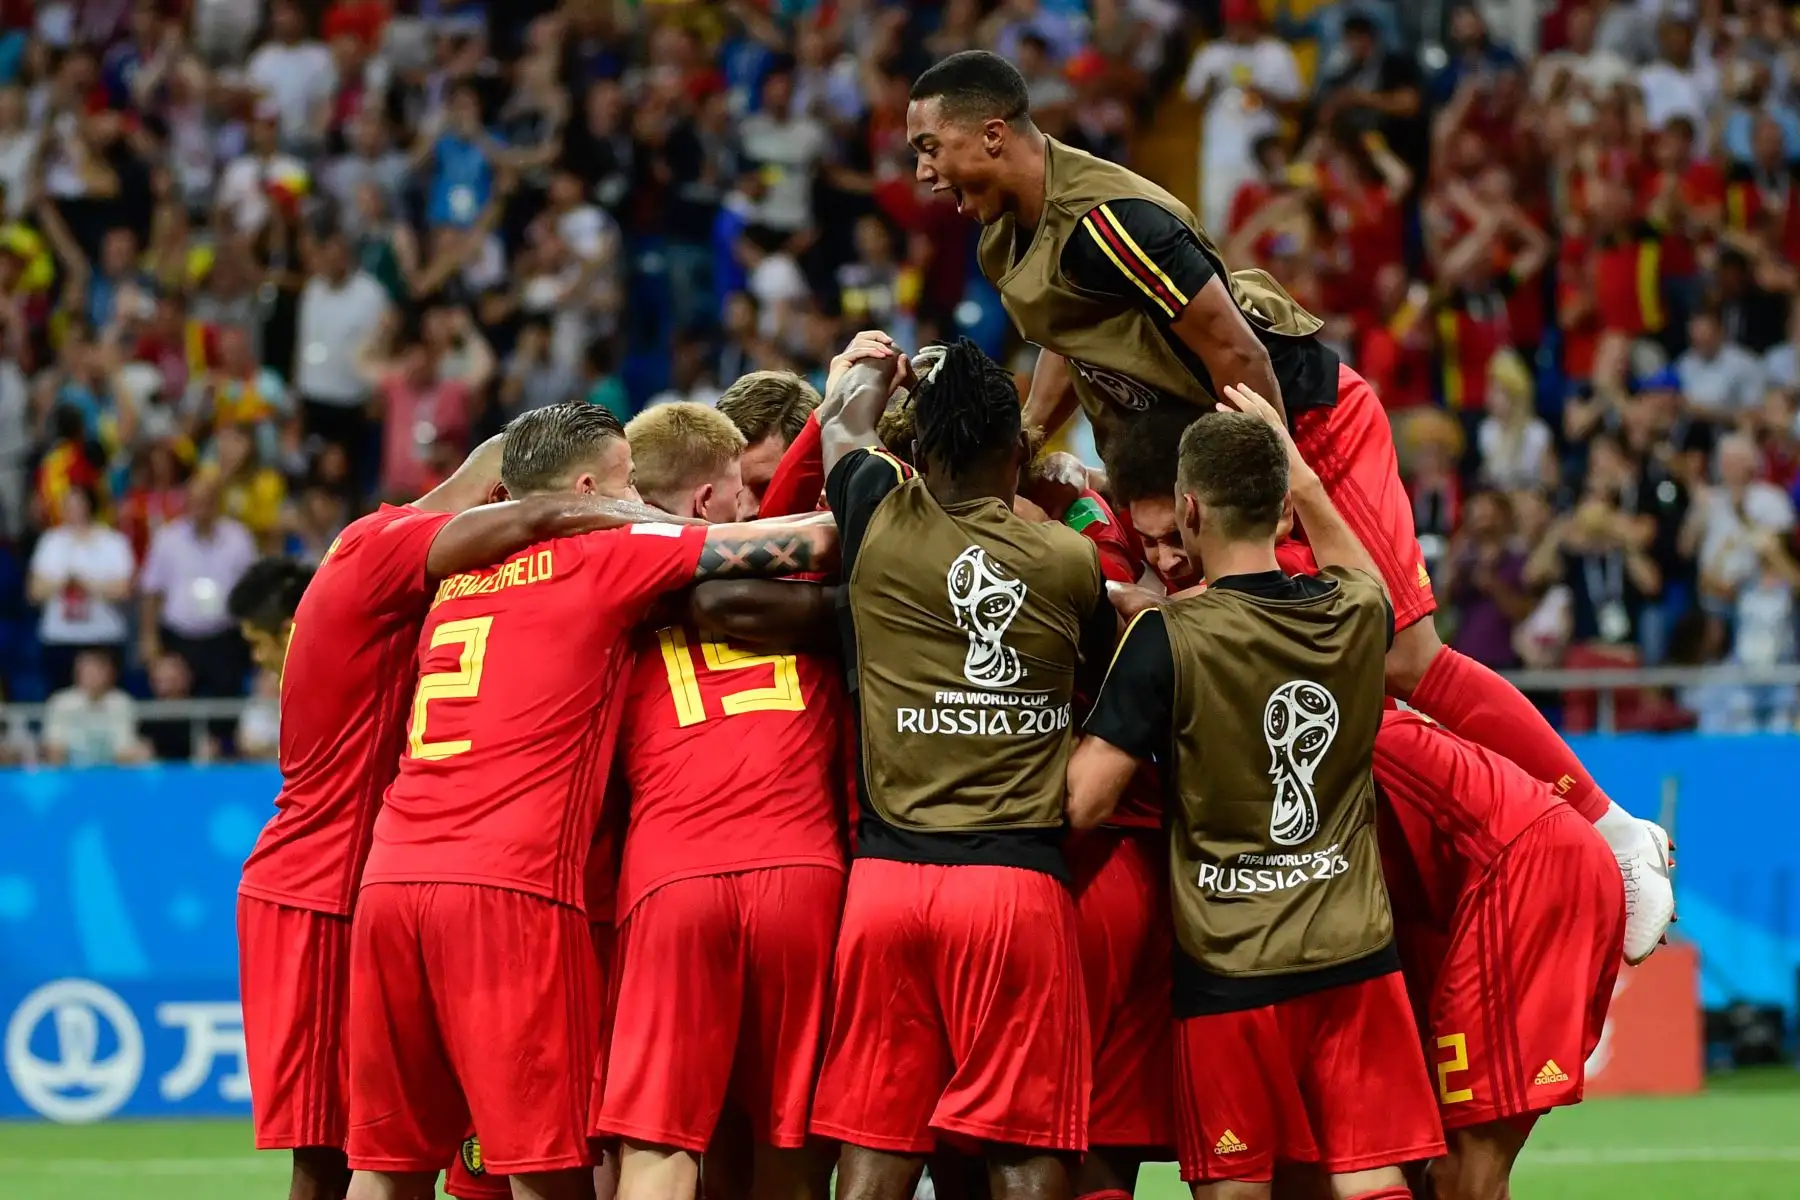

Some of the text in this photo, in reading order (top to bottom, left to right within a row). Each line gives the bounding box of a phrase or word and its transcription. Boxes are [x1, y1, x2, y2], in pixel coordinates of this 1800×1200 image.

[410, 616, 494, 760] 2
[655, 625, 806, 727] 15
[935, 691, 1049, 706] FIFA WORLD CUP
[897, 703, 1071, 735] RUSSIA 2018
[1237, 853, 1265, 866] FIFA
[1265, 853, 1312, 867] WORLD
[1197, 863, 1310, 893] RUSSIA
[1437, 1032, 1473, 1105] 2
[1533, 1073, 1569, 1086] adidas
[1213, 1142, 1248, 1155] adidas
